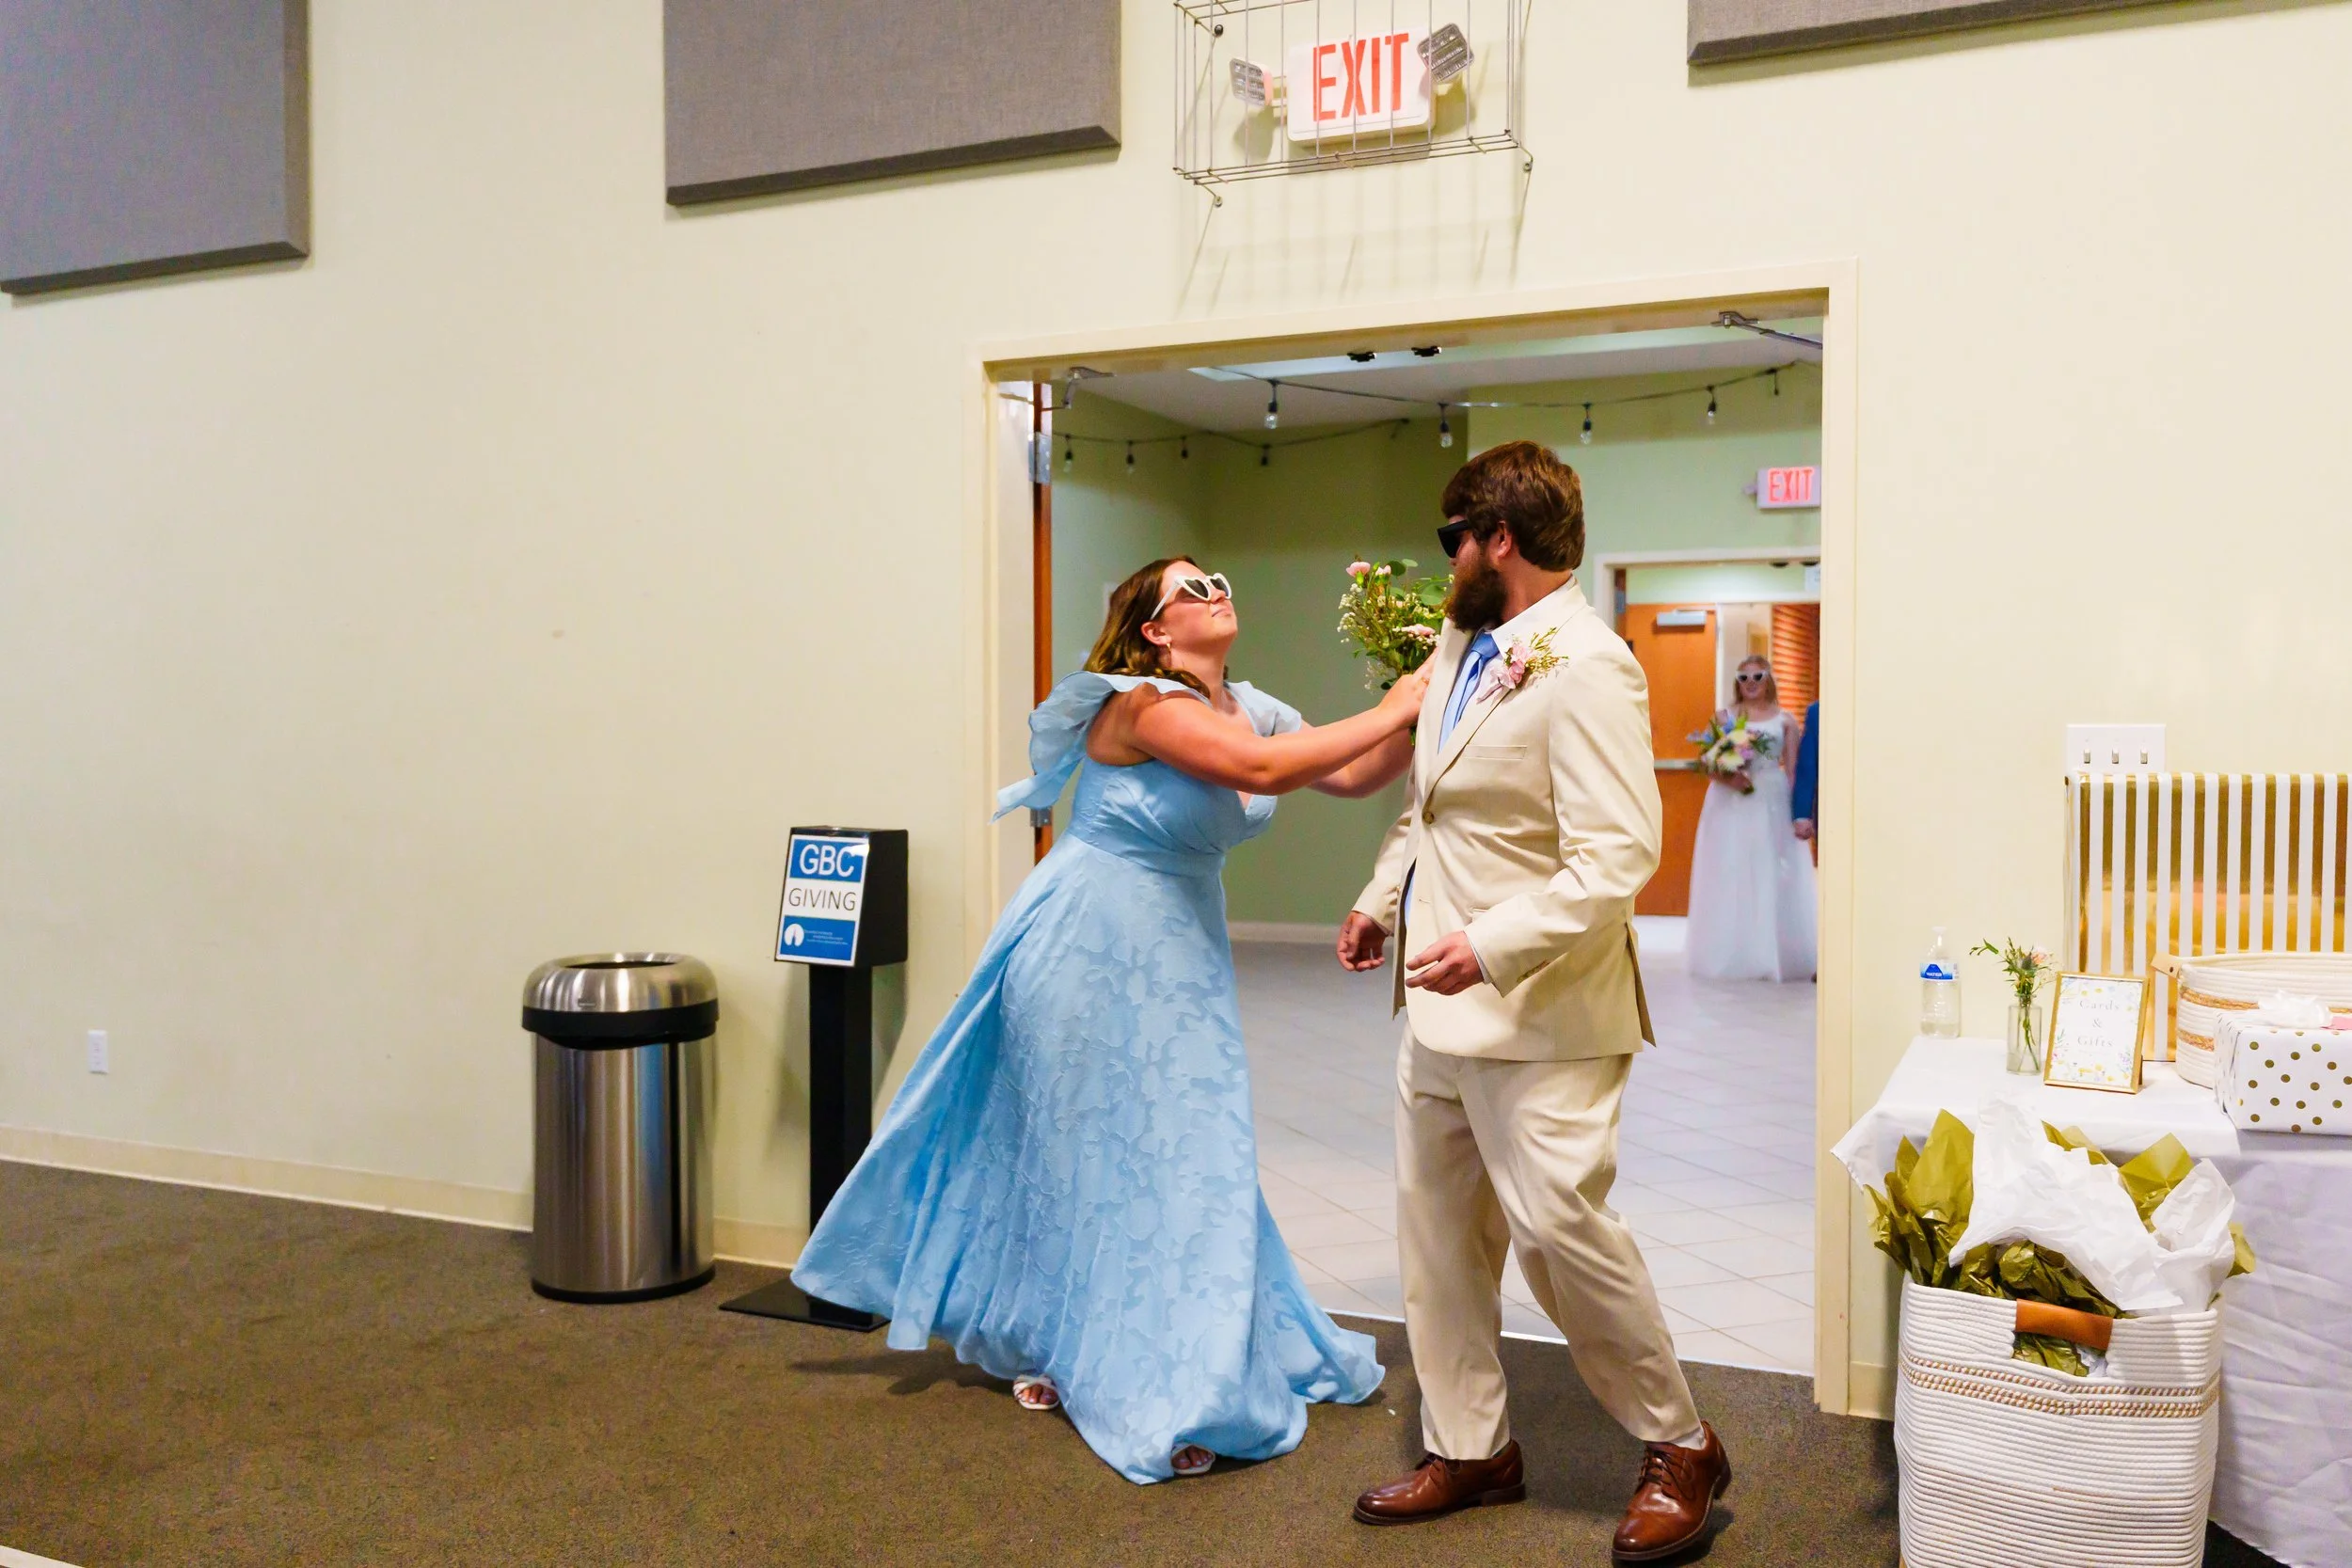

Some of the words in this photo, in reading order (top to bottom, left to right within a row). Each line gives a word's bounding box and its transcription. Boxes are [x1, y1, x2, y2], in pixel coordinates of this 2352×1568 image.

[1312, 32, 1409, 122] EXIT
[1769, 468, 1813, 502] EXIT
[799, 843, 855, 878] GBC
[788, 887, 857, 911] GIVING
[2079, 999, 2121, 1011] Cards
[2091, 1018, 2103, 1029] &
[2077, 1035, 2115, 1048] Gifts
